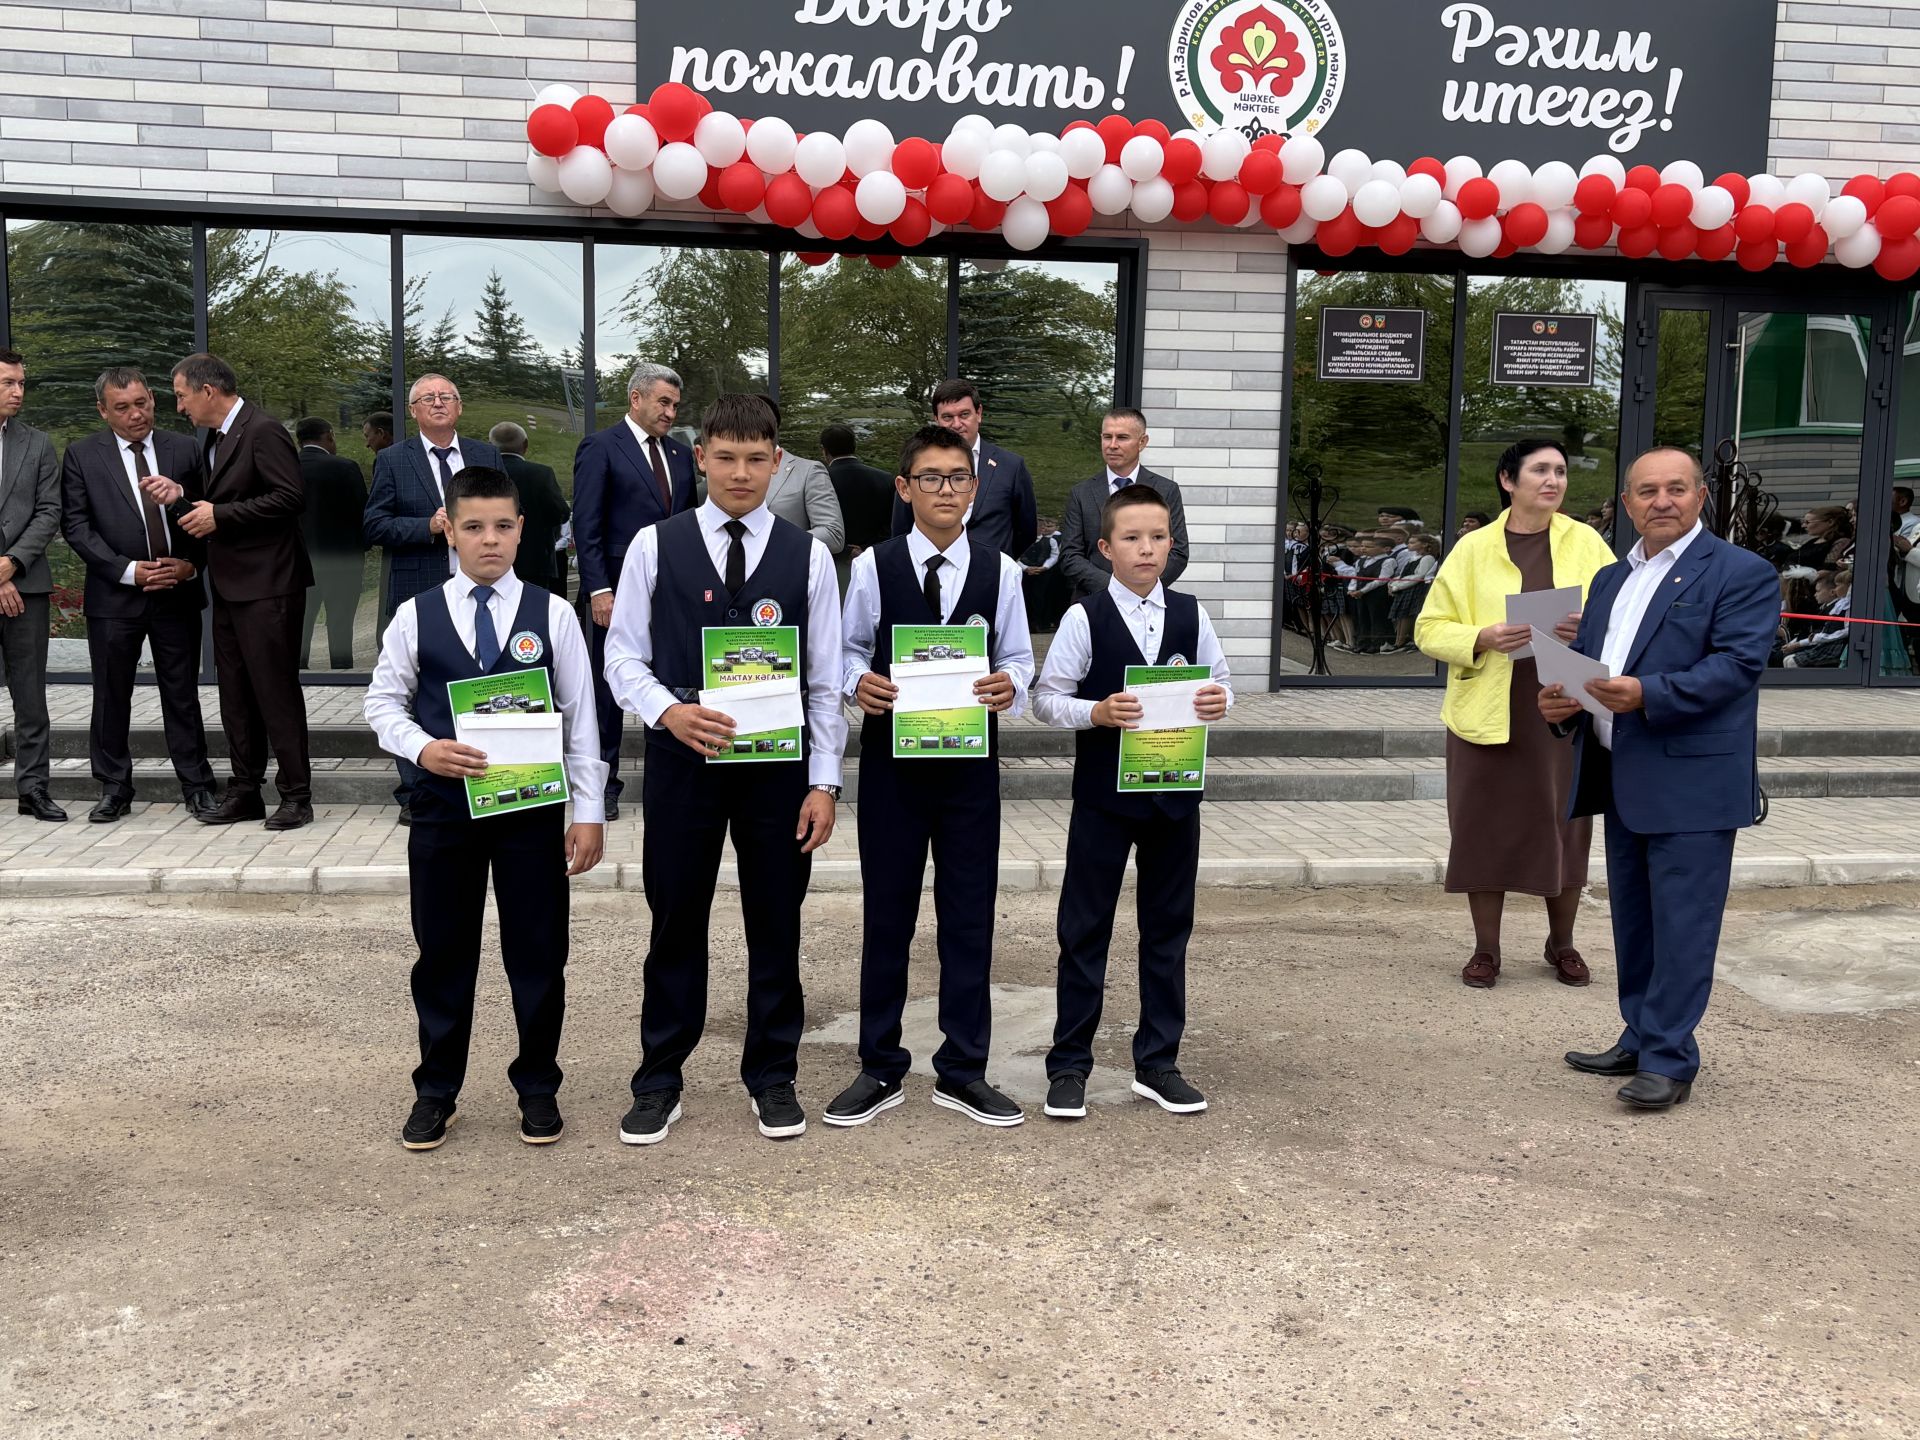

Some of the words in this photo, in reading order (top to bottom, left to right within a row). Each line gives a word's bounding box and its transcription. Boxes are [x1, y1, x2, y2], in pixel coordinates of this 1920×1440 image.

[1174, 2, 1204, 98] Р.М.Зарипов
[1317, 13, 1337, 48] урта
[1440, 2, 1658, 73] Рәхим
[669, 35, 1135, 111] пожаловать!
[1240, 93, 1275, 104] ШӘХЕС
[1317, 53, 1339, 114] мәктәбе
[1233, 102, 1280, 114] МӘКТӘБЕ
[1442, 67, 1684, 153] итегез!
[719, 674, 753, 682] МАКТАУ
